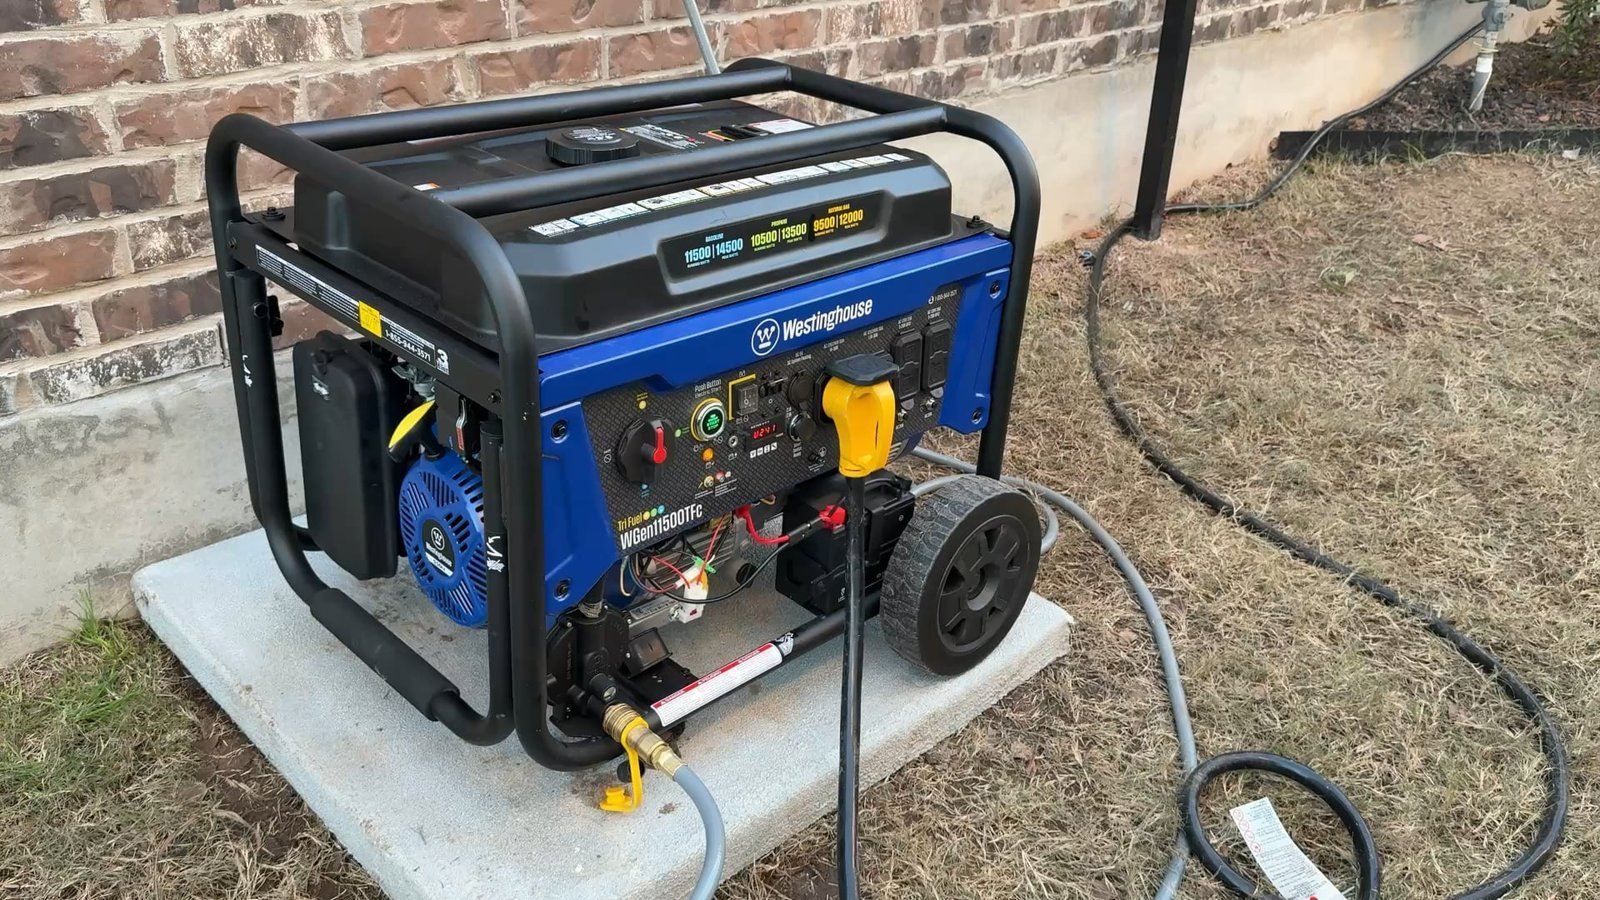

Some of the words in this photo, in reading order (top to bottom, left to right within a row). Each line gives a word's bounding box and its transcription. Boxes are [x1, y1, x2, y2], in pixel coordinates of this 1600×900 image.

[813, 216, 835, 232] 9500
[839, 209, 864, 226] 12000
[751, 230, 777, 247] 10500
[781, 223, 807, 240] 13500
[685, 246, 711, 263] 11500
[716, 238, 743, 256] 14500
[783, 299, 873, 341] Westinghouse
[437, 349, 448, 363] 3
[695, 383, 706, 393] Push
[706, 379, 722, 389] Button
[618, 517, 627, 532] Tri
[627, 512, 643, 528] Fuel
